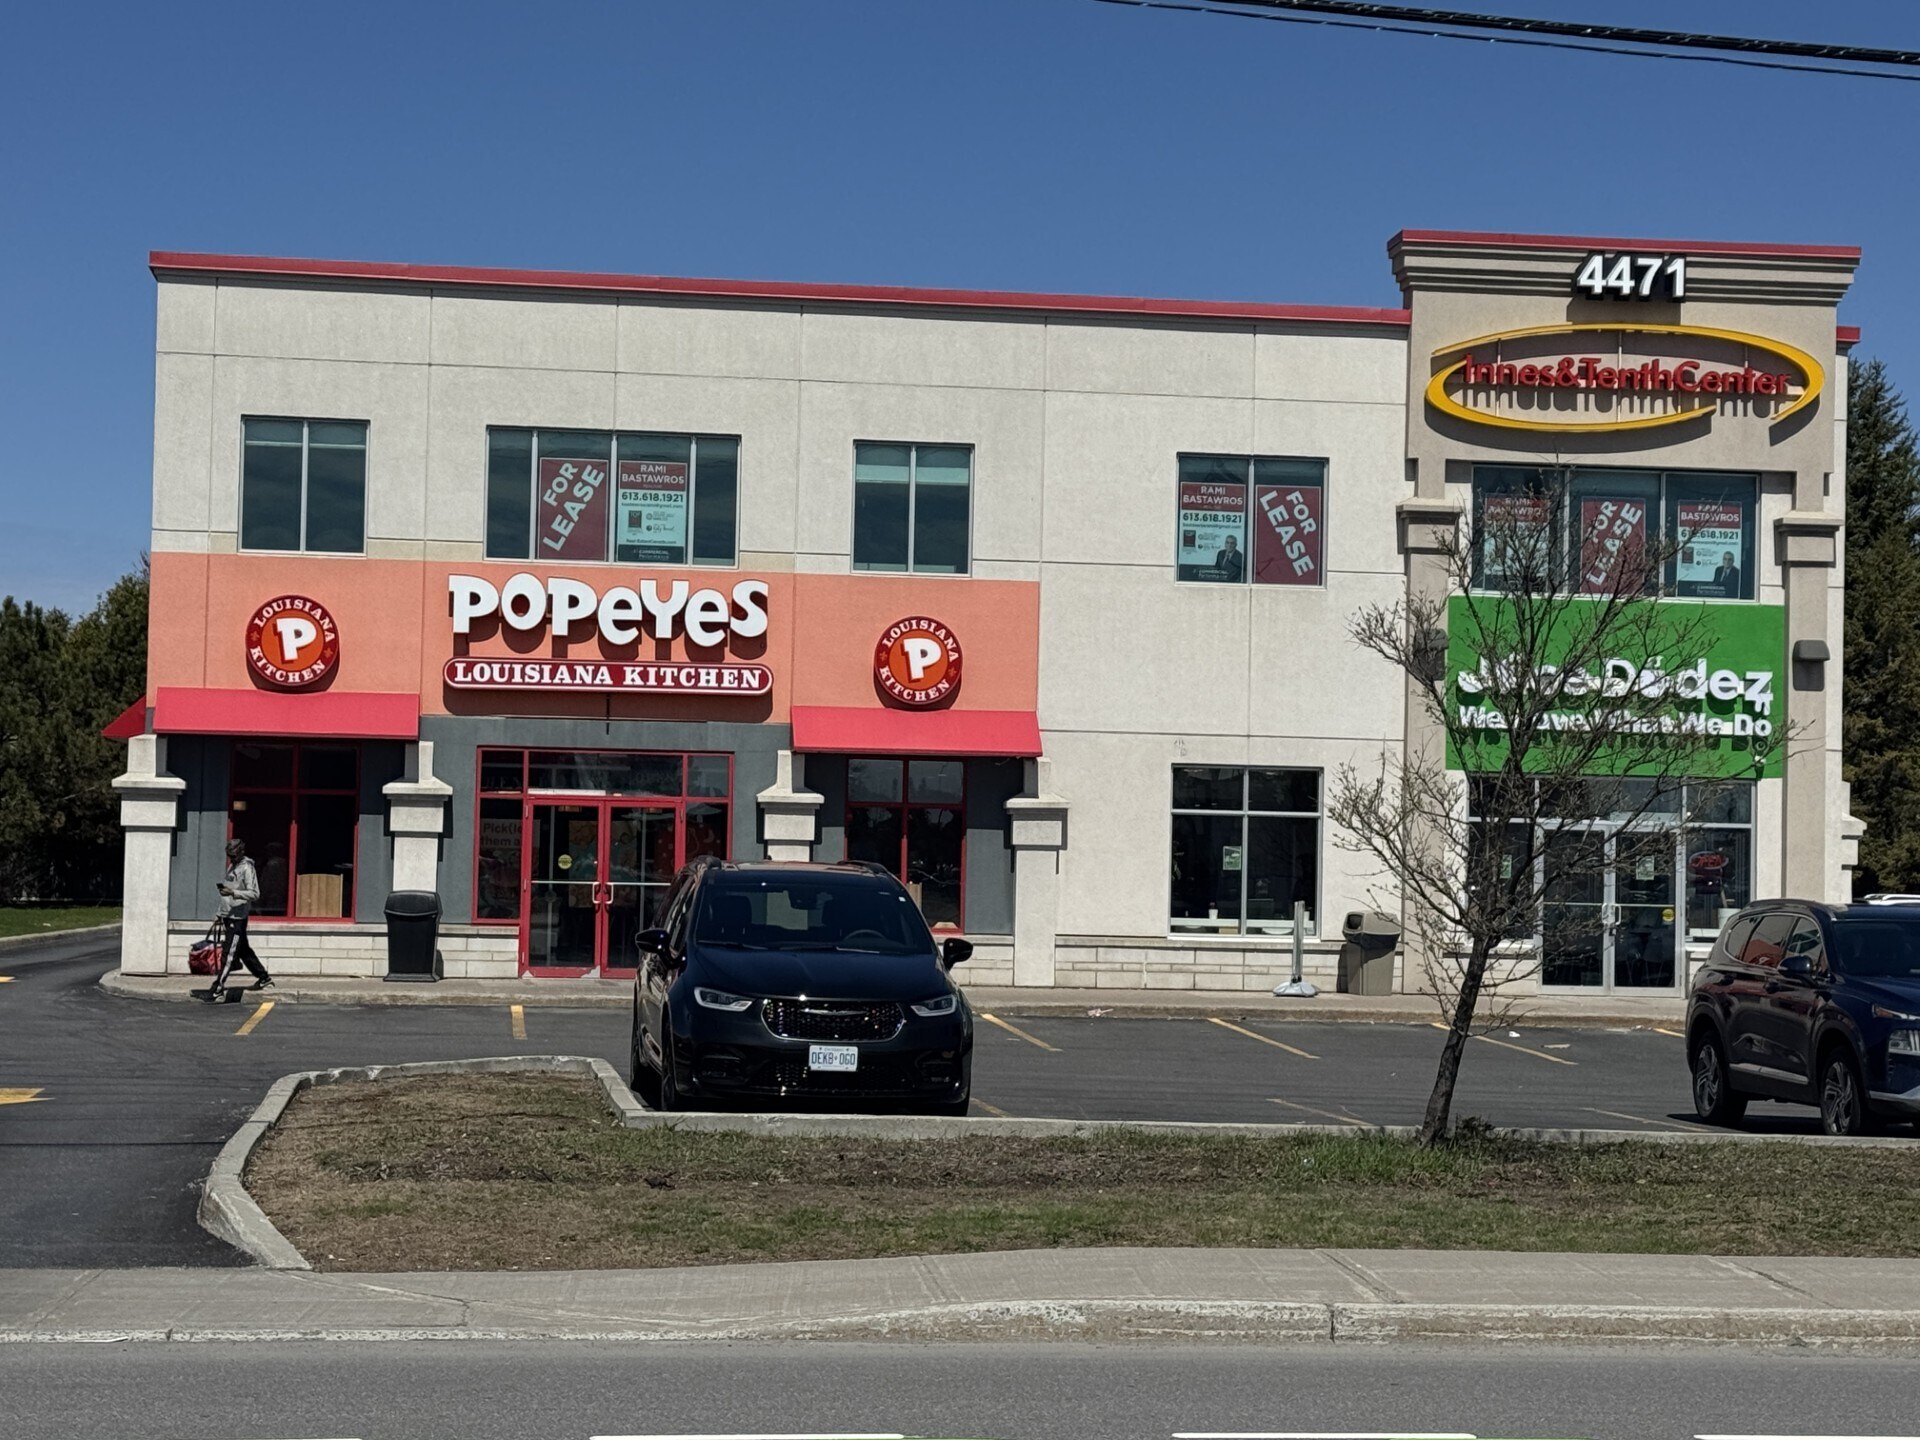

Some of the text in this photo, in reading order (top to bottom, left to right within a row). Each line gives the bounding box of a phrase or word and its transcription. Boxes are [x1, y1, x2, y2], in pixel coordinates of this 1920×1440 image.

[1577, 255, 1685, 297] 4471
[543, 463, 578, 507] FOR
[622, 473, 685, 484] BASTAWROS
[640, 464, 667, 474] RAMI
[543, 465, 605, 551] LEASE
[621, 491, 684, 503] 613.618.1921
[1182, 494, 1243, 506] BASTAWROS
[1201, 486, 1226, 496] RAMI
[1182, 512, 1242, 524] 613.618.1921
[1286, 490, 1317, 535] FOR
[1259, 490, 1315, 577] LEASE
[254, 598, 336, 643] LOUISIANA
[276, 617, 317, 661] P
[881, 619, 959, 662] LOUISIANA
[903, 637, 942, 680] P
[250, 645, 326, 683] KITCHEN
[454, 662, 762, 689] LOUISIANA KITCHEN
[879, 666, 950, 702] KITCHEN
[1734, 713, 1772, 737] Do
